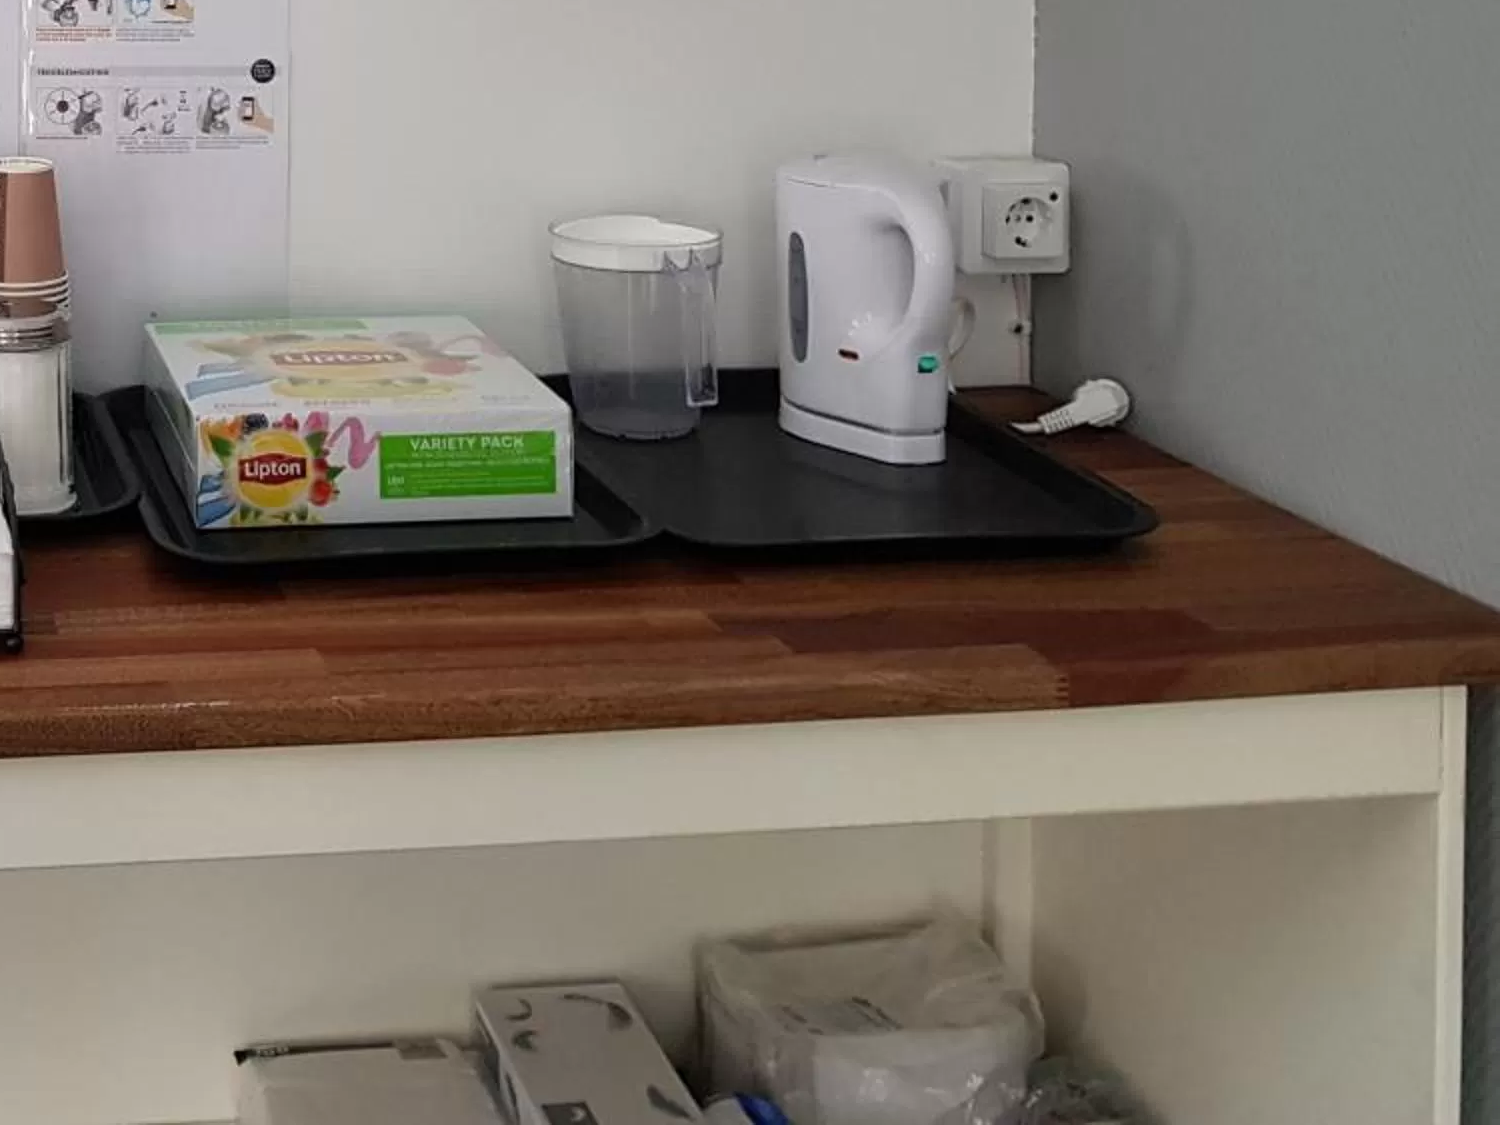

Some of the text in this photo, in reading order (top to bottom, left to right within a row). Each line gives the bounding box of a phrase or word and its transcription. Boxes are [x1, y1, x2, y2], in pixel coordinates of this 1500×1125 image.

[410, 435, 525, 452] VARIETY PACK
[244, 457, 302, 478] Lipton
